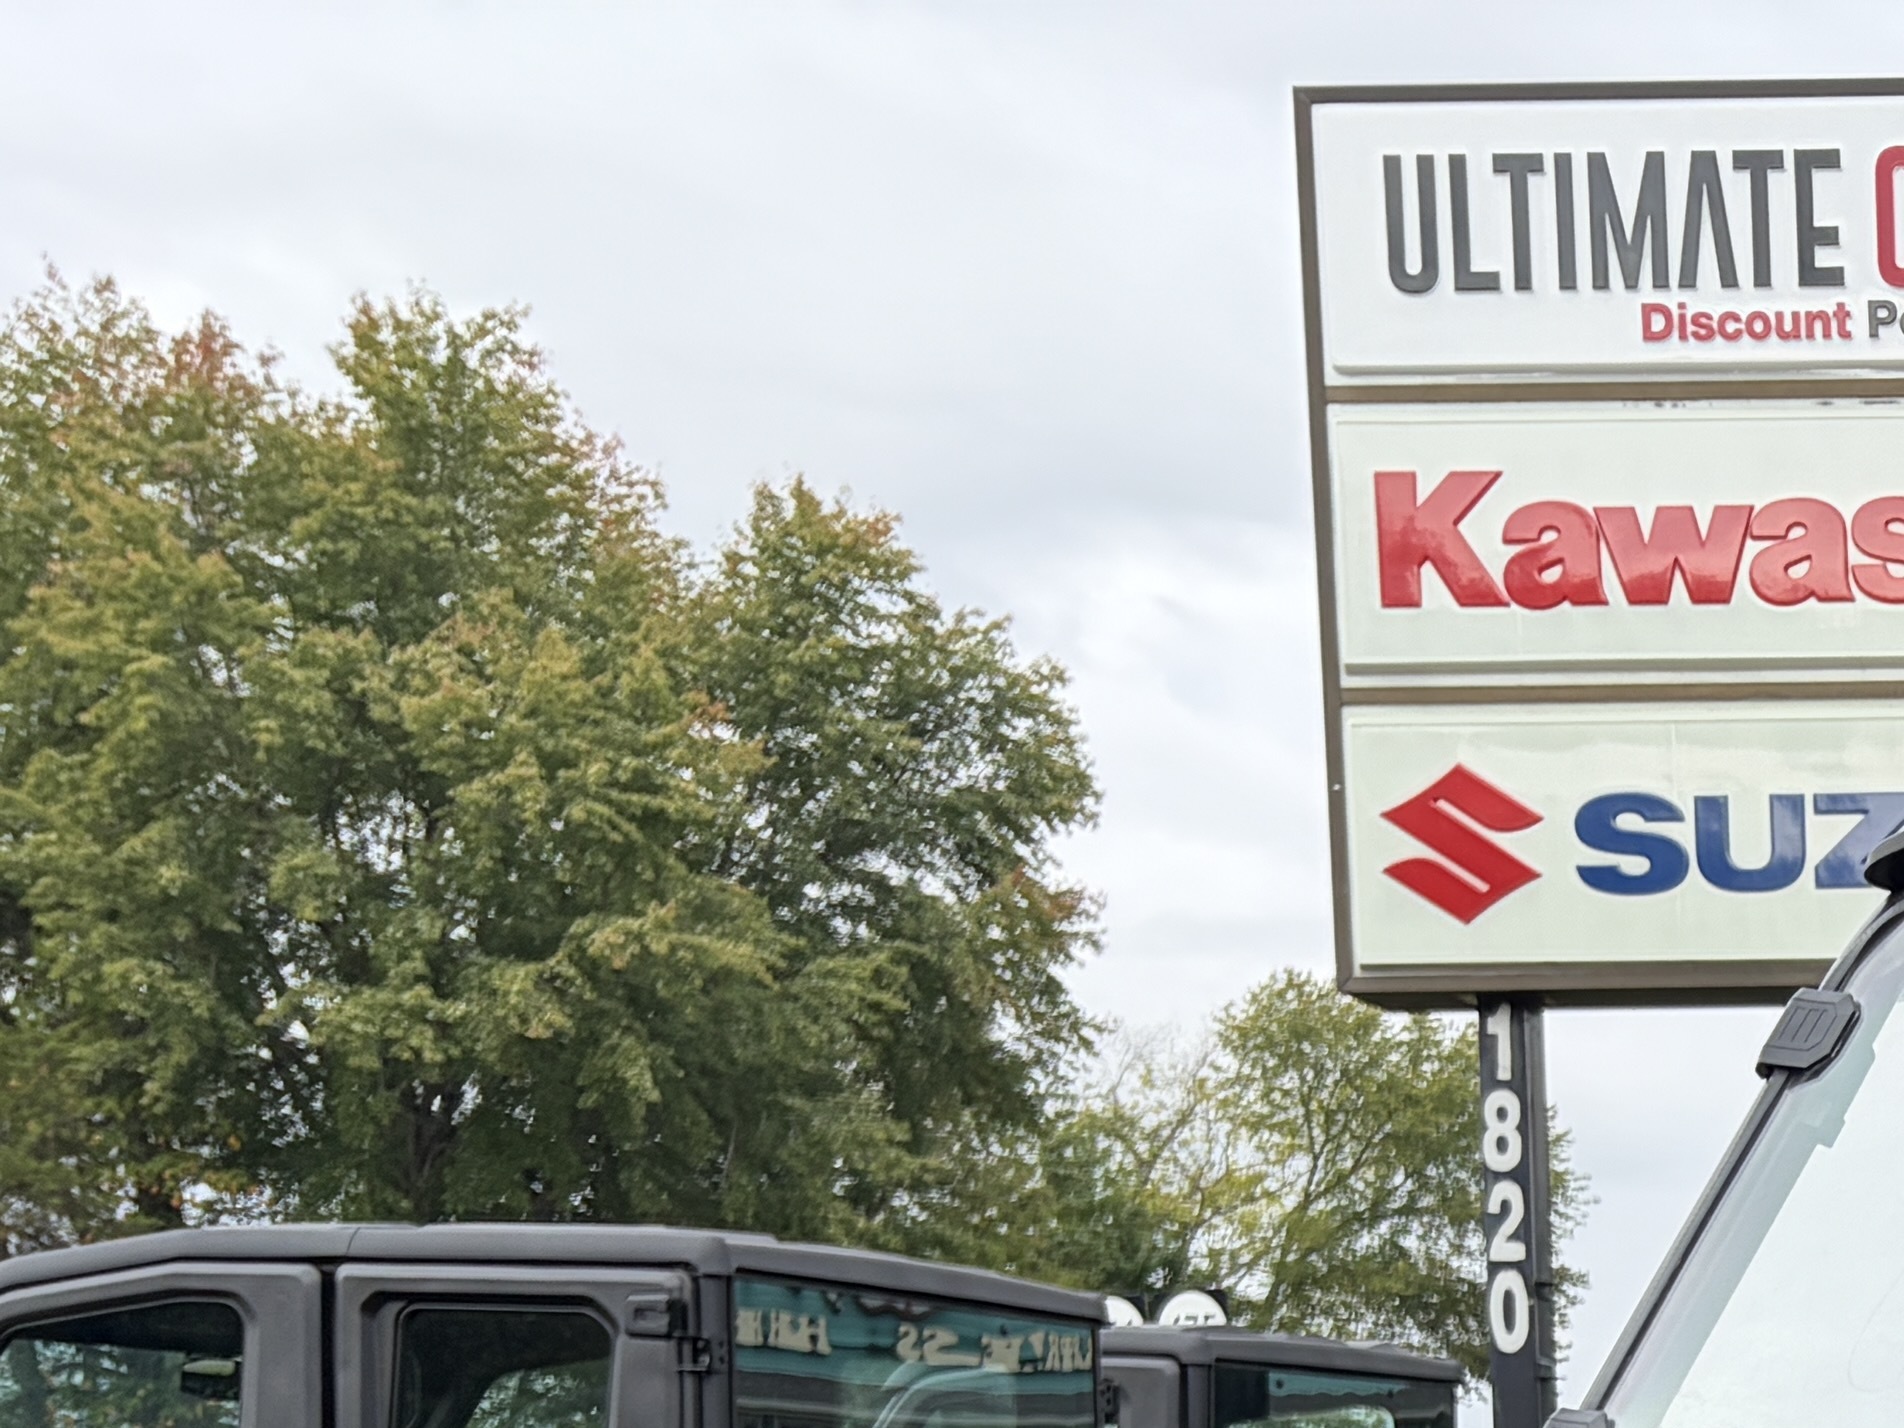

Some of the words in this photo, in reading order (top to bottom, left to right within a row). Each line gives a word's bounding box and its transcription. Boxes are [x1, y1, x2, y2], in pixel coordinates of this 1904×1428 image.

[1382, 146, 1845, 294] ULTIMATE
[1641, 301, 1852, 343] Discount
[1482, 1003, 1530, 1354] 1820
